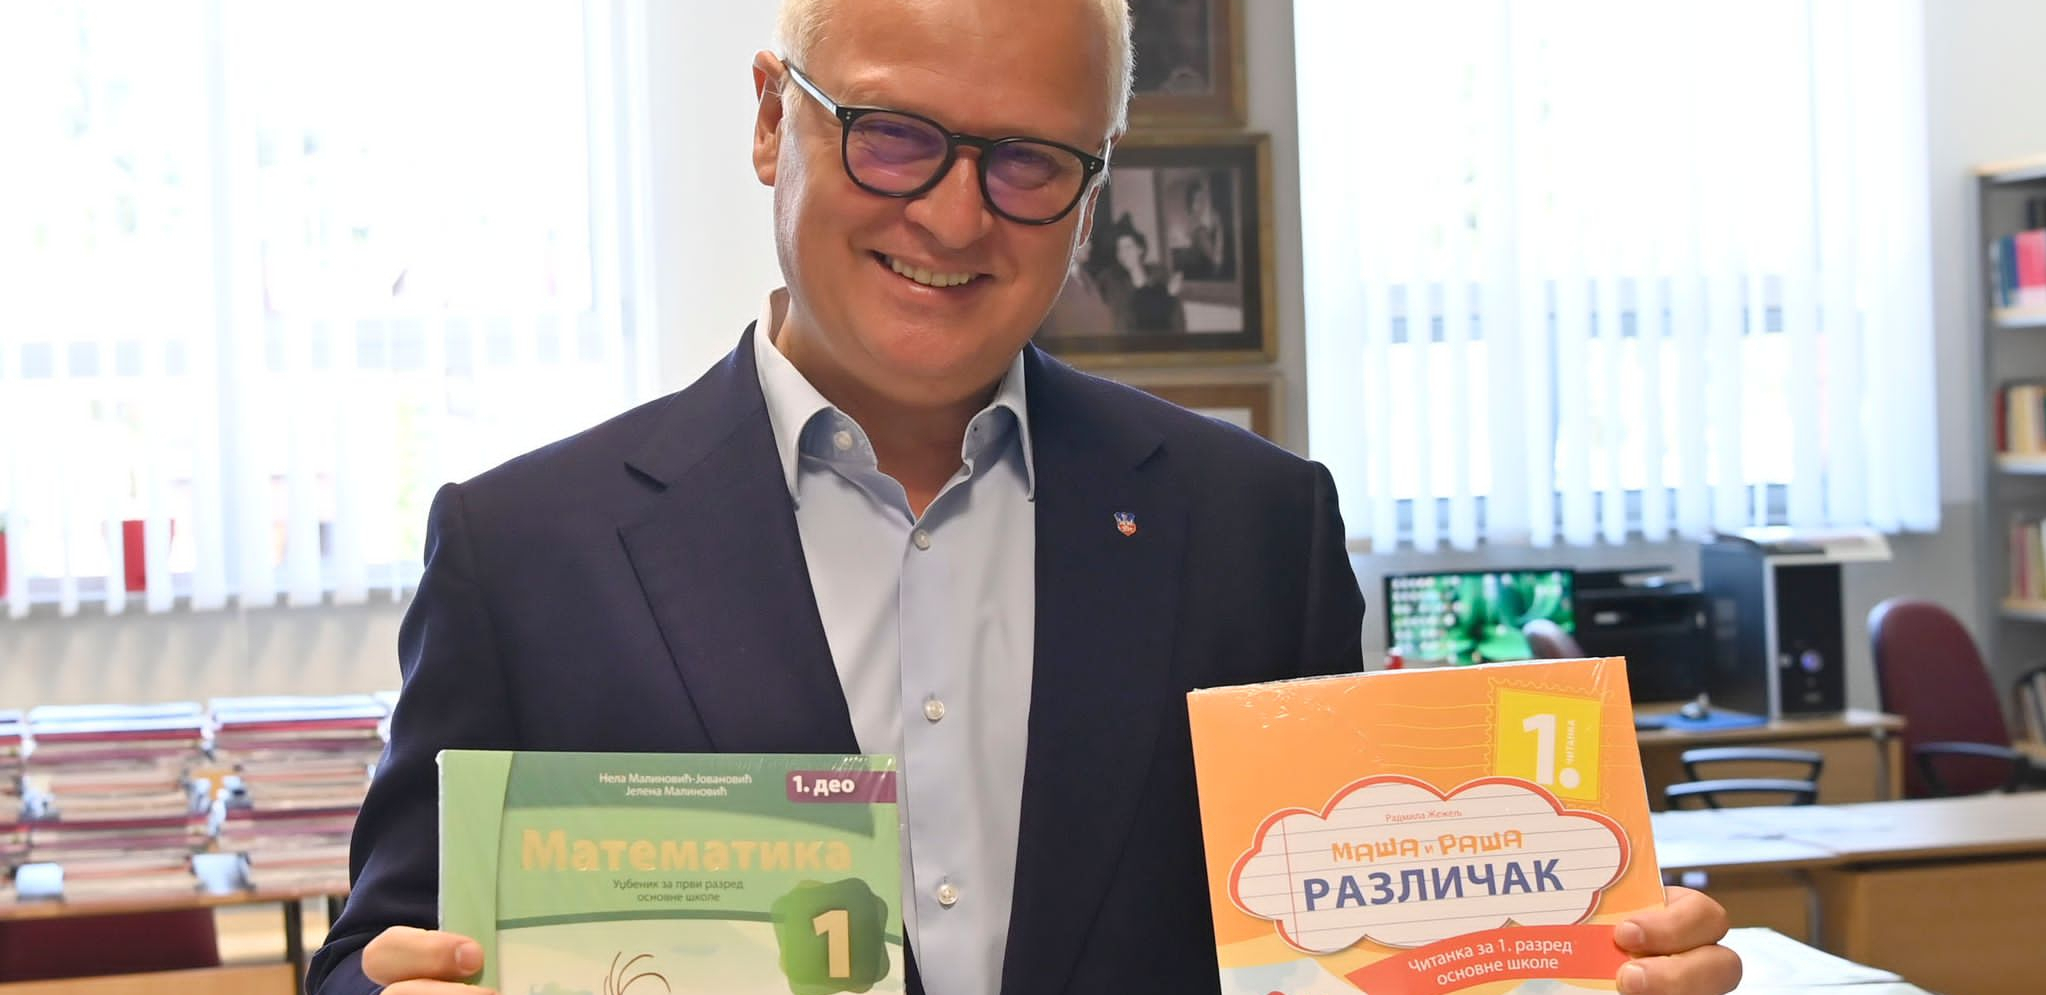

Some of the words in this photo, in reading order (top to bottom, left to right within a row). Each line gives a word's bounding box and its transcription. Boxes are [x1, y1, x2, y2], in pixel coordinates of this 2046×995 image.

[1523, 713, 1581, 789] 1.
[599, 772, 626, 784] Нела
[625, 786, 662, 797] Јелена
[664, 786, 728, 797] Малиновић
[792, 775, 810, 793] 1.
[813, 779, 855, 797] део
[521, 829, 853, 872] Математика
[636, 893, 684, 902] основне
[685, 893, 721, 902] школе
[662, 881, 673, 889] за
[675, 880, 702, 891] први
[704, 880, 744, 891] разред
[1303, 858, 1565, 912] РАЗЛИЧАК
[813, 909, 851, 979] 1
[1408, 945, 1474, 972] Читанка
[1478, 942, 1494, 956] за
[1498, 938, 1512, 953] 1.
[1515, 939, 1573, 954] разред
[1437, 961, 1503, 986] основне
[1507, 958, 1559, 970] школе
